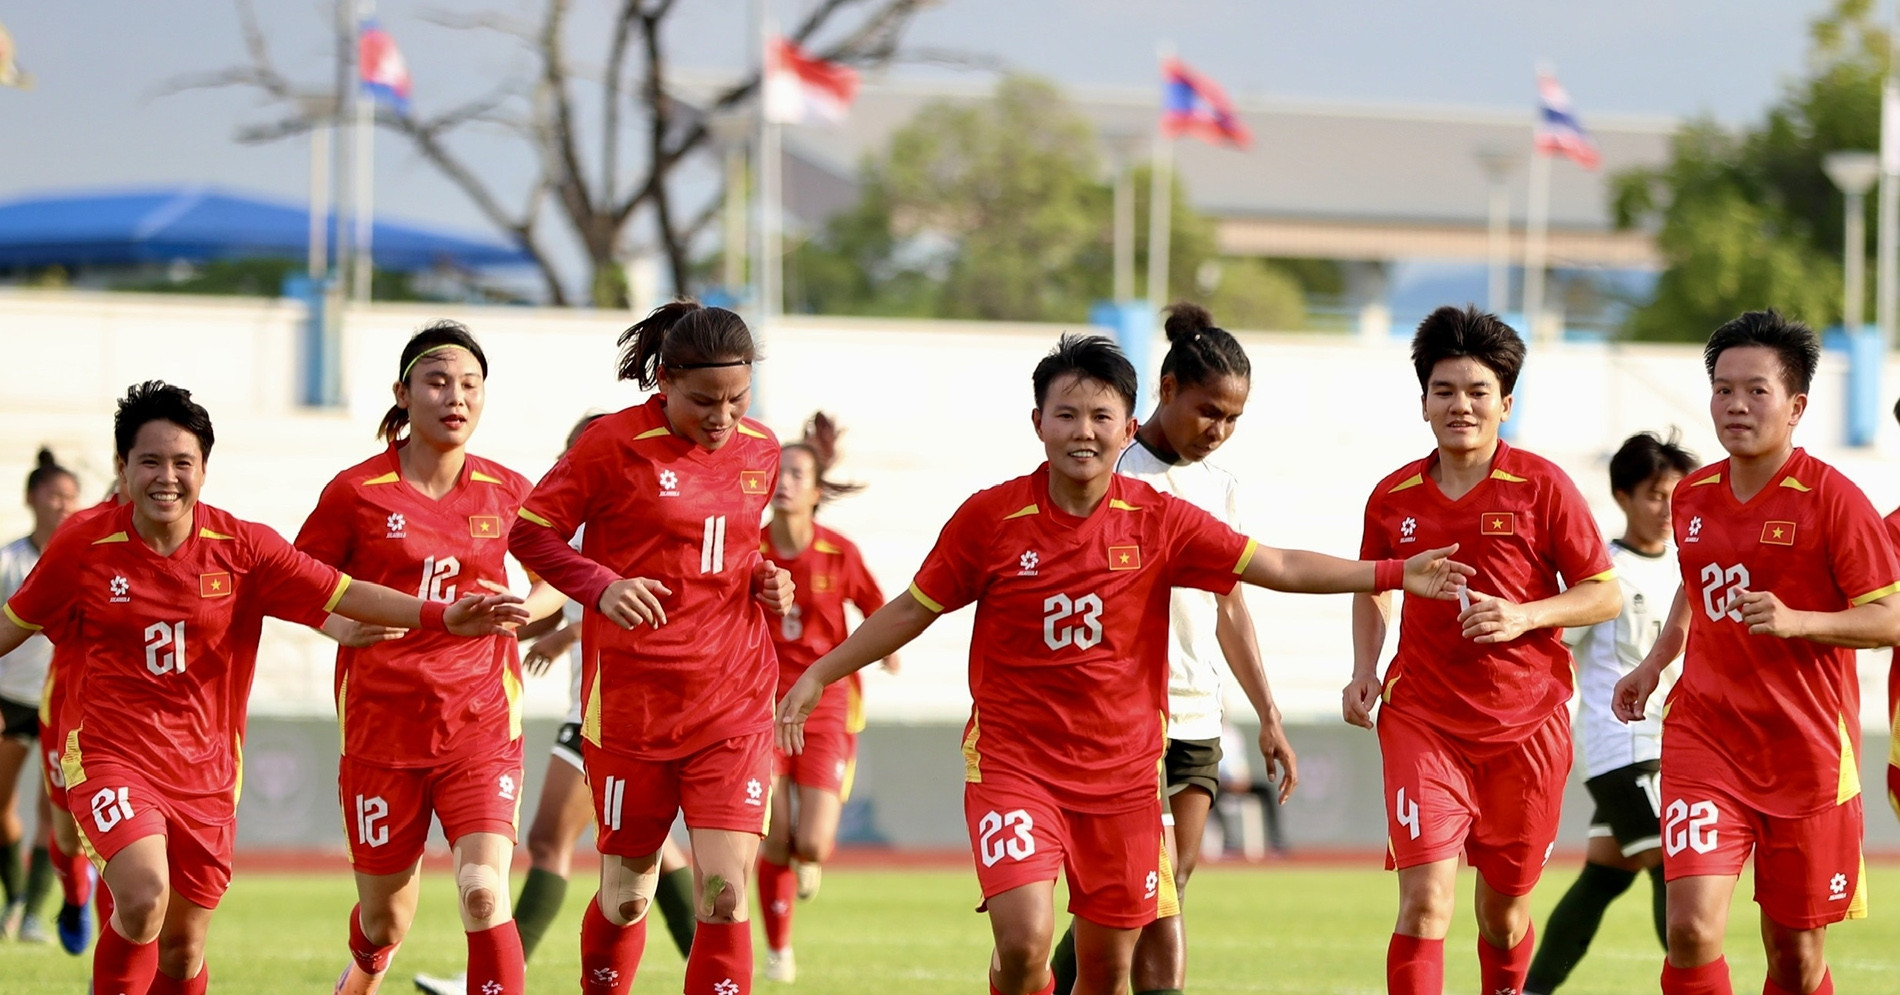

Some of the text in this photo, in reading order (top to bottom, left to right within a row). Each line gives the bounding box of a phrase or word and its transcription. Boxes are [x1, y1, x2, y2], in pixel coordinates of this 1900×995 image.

[700, 514, 726, 575] 11
[418, 555, 461, 604] 12
[144, 620, 187, 676] 21
[1043, 592, 1104, 651] 23
[91, 786, 135, 833] 21
[356, 794, 389, 848] 12
[603, 775, 625, 831] 11
[1396, 786, 1421, 841] 4
[1665, 798, 1720, 858] 22
[979, 808, 1036, 868] 23
